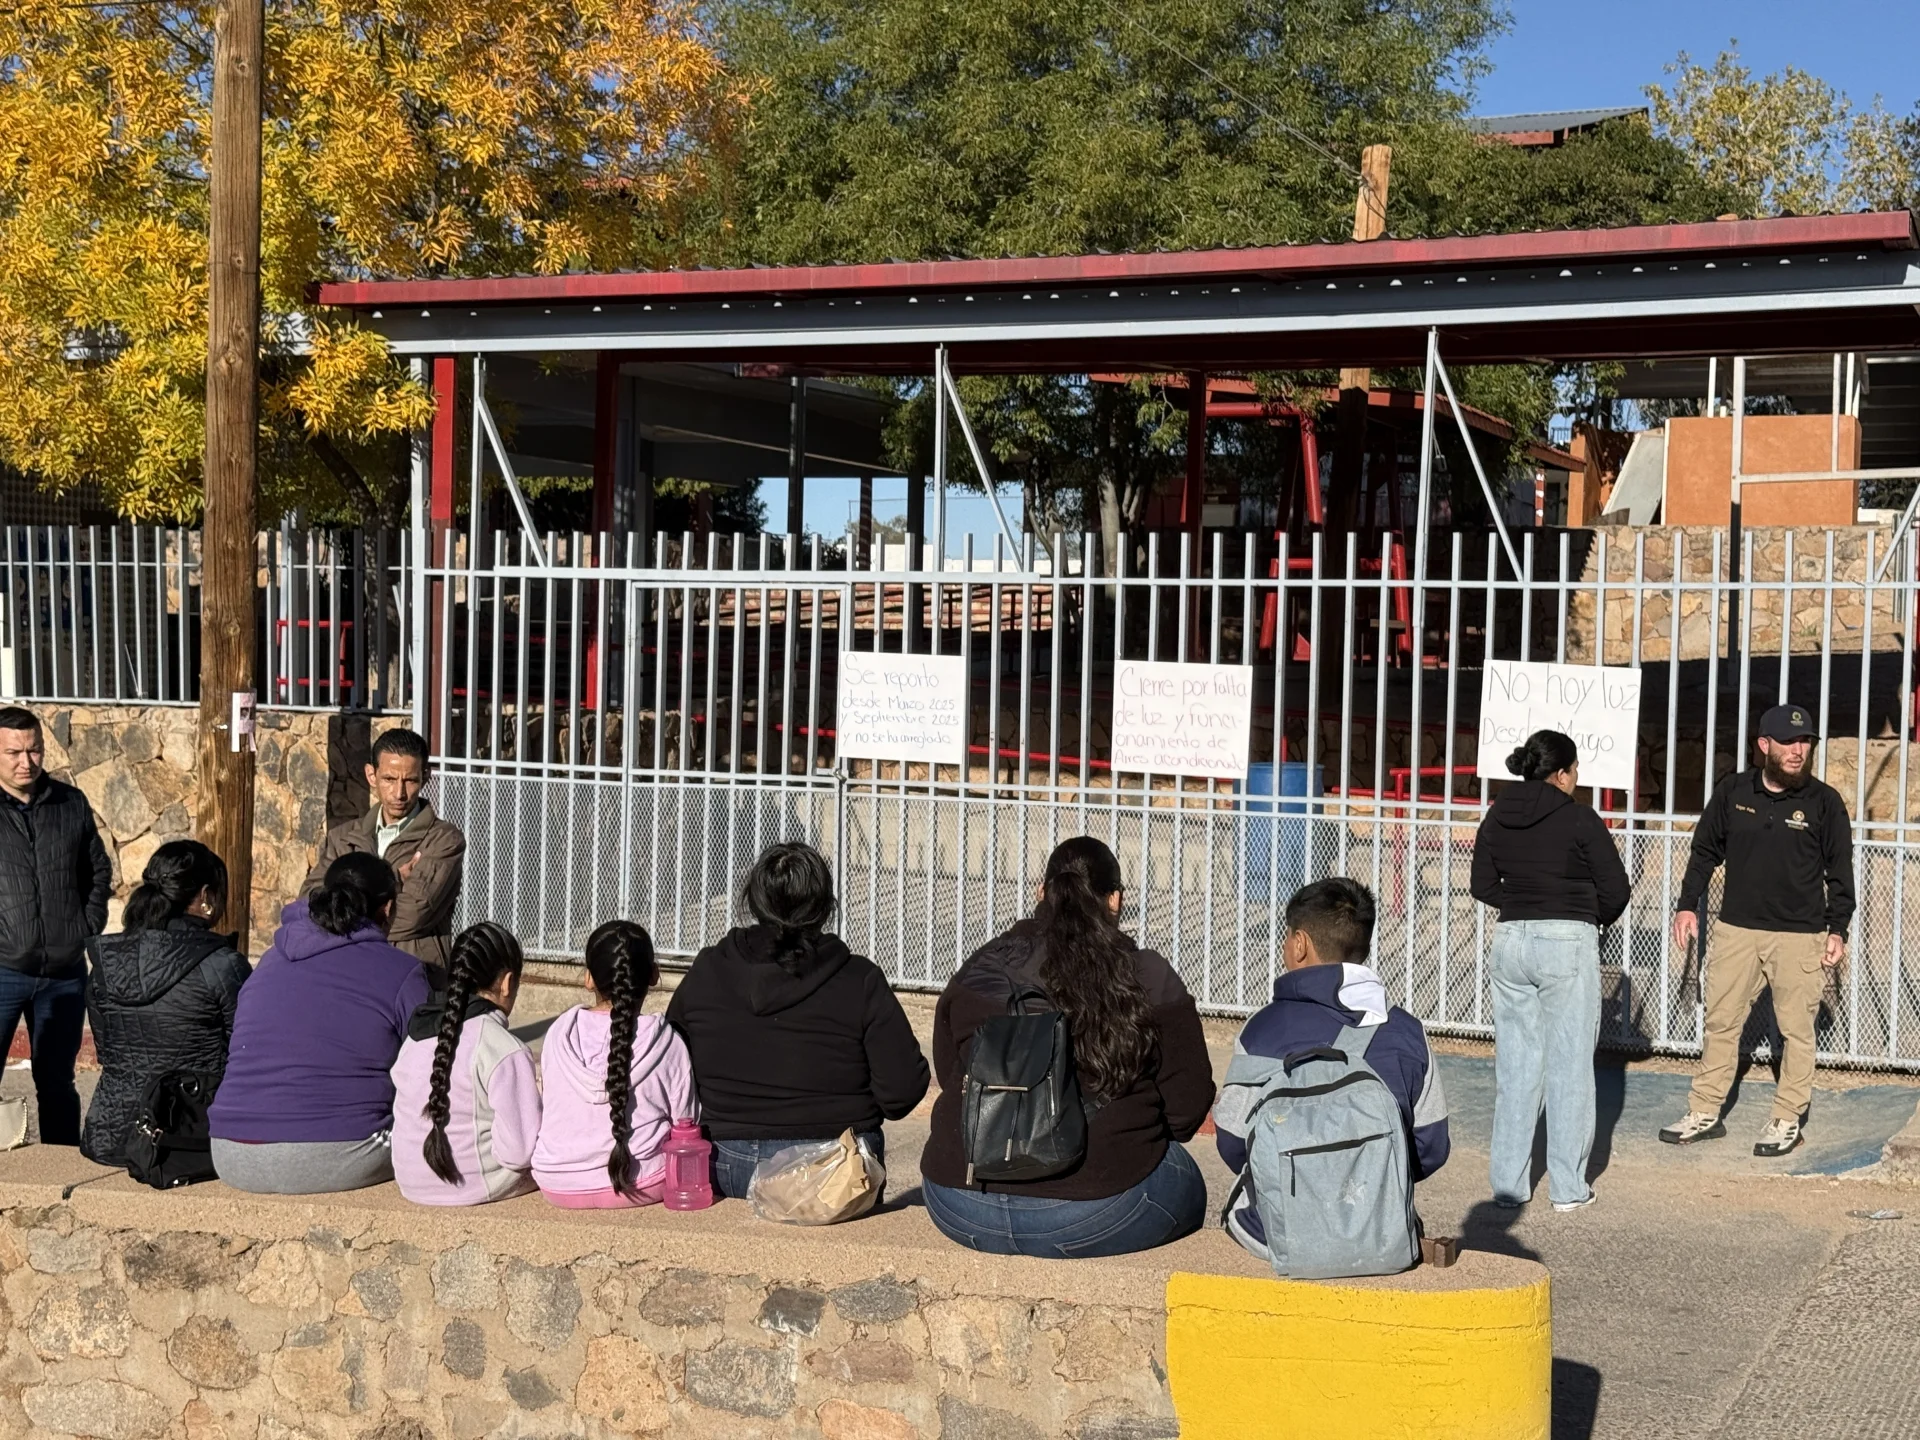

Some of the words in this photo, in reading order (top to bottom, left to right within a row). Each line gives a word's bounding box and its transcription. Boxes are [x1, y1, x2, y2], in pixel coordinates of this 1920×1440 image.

[845, 653, 878, 685] Se
[1119, 666, 1176, 697] Cierre
[1182, 679, 1208, 706] por
[1213, 671, 1248, 698] falta
[1489, 662, 1530, 703] No
[1603, 671, 1640, 711] luz
[842, 689, 881, 709] desde
[888, 695, 925, 711] Marzo
[929, 698, 955, 711] 2025
[840, 712, 848, 728] y
[854, 710, 926, 729] Septiembre
[932, 713, 960, 726] 2025
[1115, 699, 1136, 727] de
[1142, 703, 1168, 726] luz
[1174, 713, 1185, 734] y
[843, 732, 851, 747] y
[855, 732, 869, 744] no
[873, 732, 885, 743] se
[1115, 731, 1200, 749] onamiento
[1207, 734, 1228, 750] de
[1113, 749, 1149, 765] Aires
